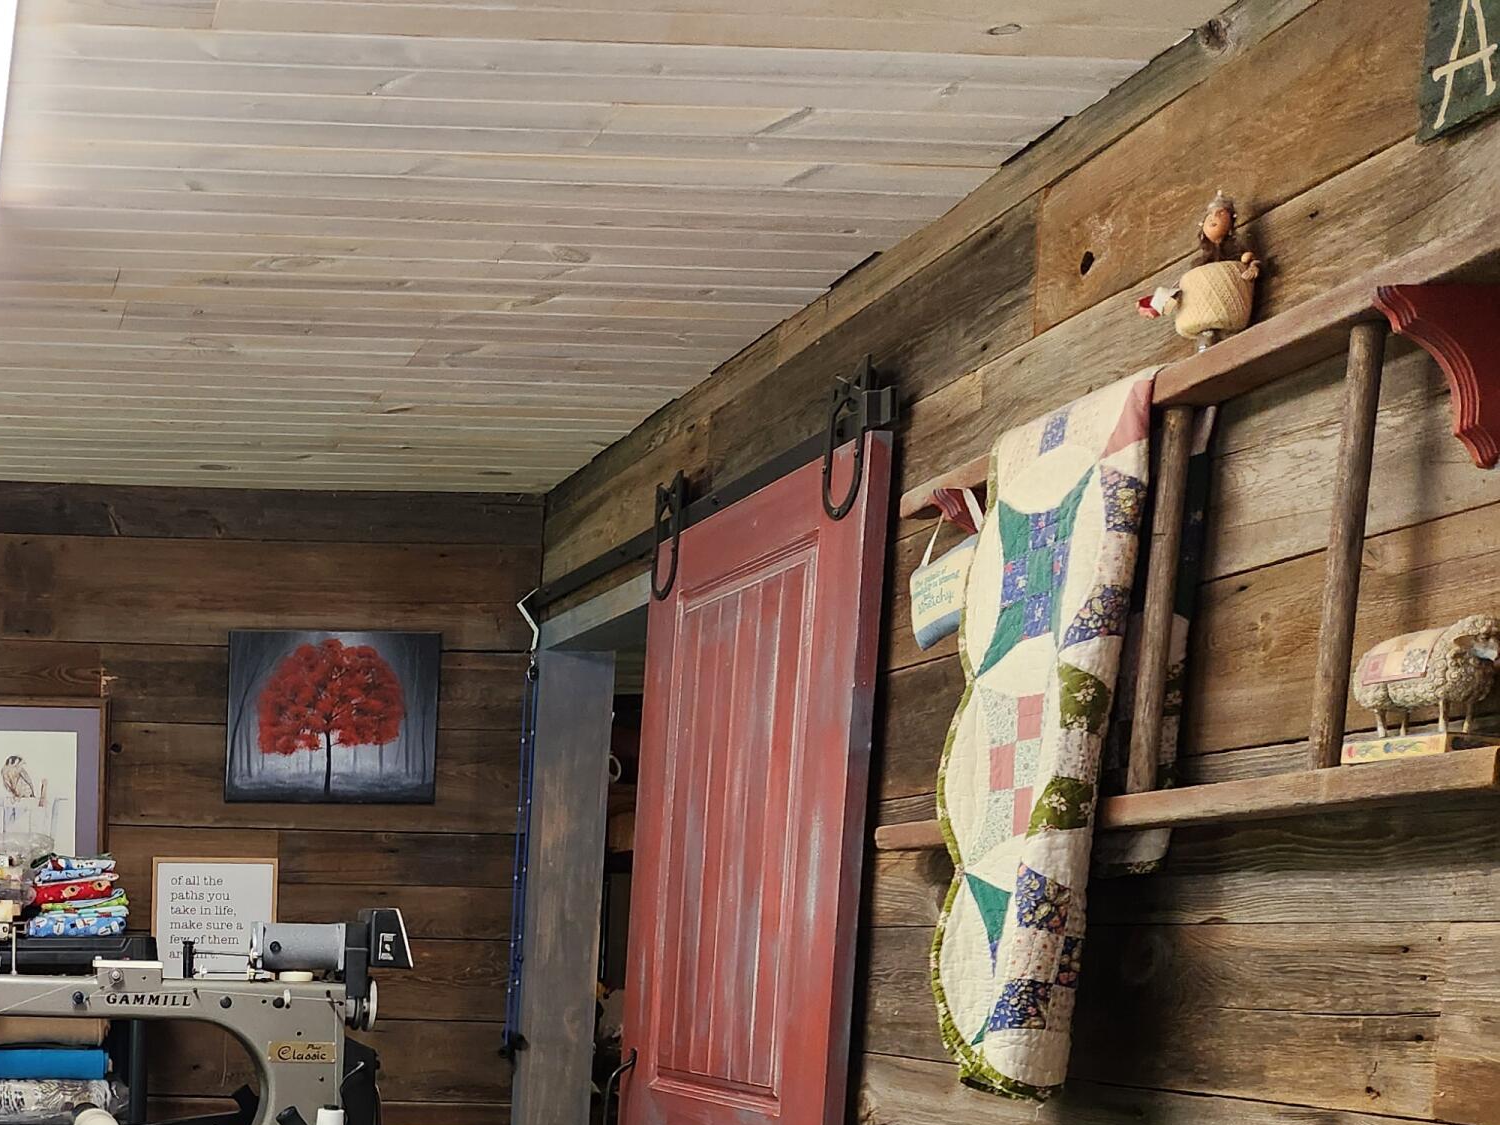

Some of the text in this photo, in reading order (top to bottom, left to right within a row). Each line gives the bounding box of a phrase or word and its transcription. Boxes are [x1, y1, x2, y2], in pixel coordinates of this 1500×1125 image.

[171, 876, 223, 886] of all the
[171, 891, 230, 902] paths you
[170, 906, 237, 917] take in life,
[170, 920, 244, 930] make sure a
[194, 935, 206, 945] of
[208, 935, 239, 945] them
[106, 993, 191, 1006] GAMMILL
[277, 1045, 326, 1060] Classic
